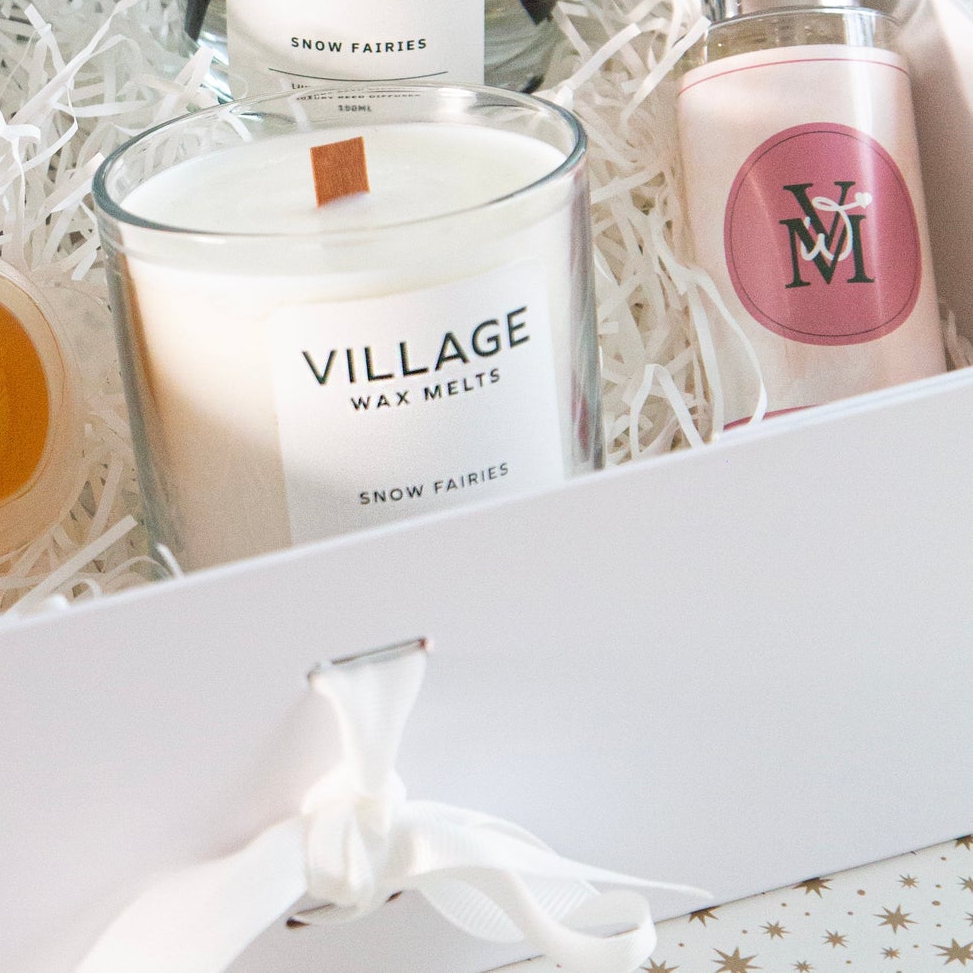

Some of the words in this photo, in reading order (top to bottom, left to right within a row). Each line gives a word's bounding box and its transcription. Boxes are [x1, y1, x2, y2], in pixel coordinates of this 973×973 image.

[291, 37, 343, 53] SNOW
[351, 38, 428, 53] FAIRIES
[302, 306, 531, 386] VILLAGE
[350, 390, 411, 412] WAX
[424, 368, 502, 402] MELTS
[359, 484, 424, 505] SNOW
[434, 462, 509, 494] FAIRIES
